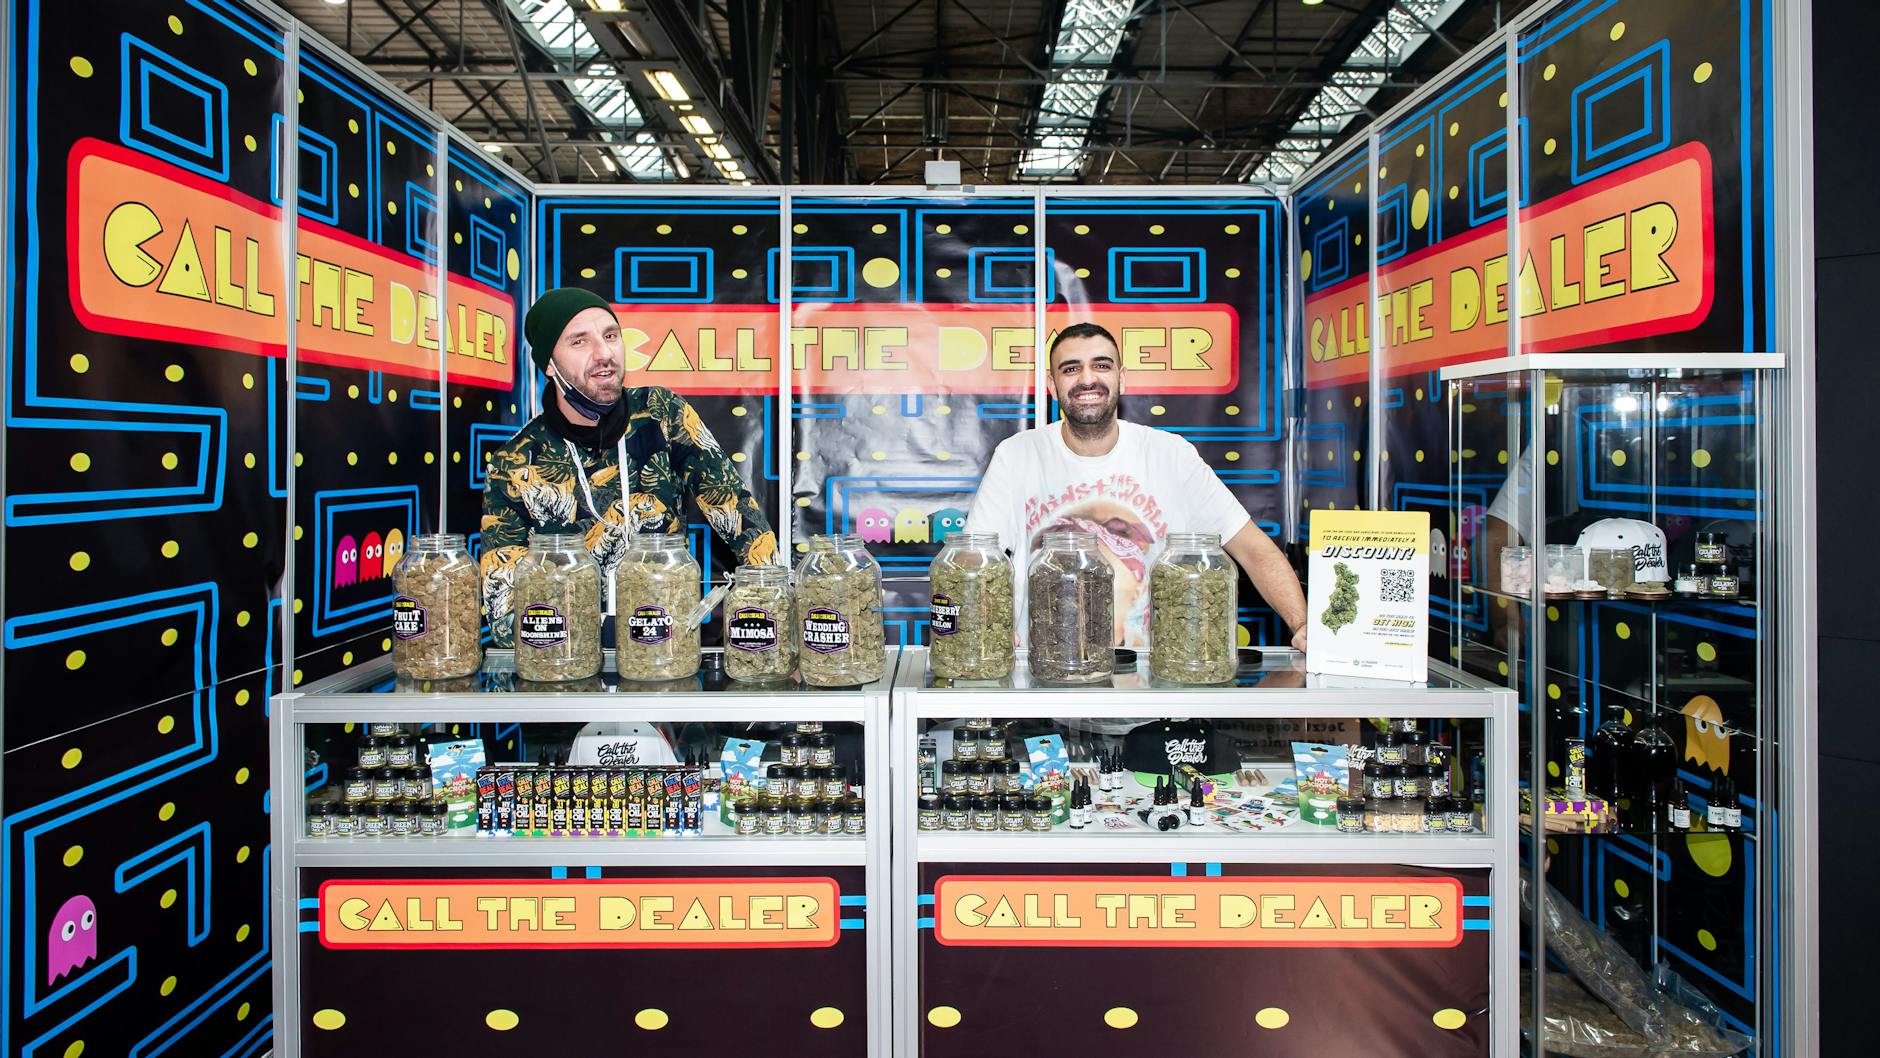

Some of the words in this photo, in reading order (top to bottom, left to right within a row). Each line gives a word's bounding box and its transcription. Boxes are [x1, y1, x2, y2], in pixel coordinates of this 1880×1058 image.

[103, 201, 275, 316] CALL
[296, 252, 374, 336] THE
[1310, 304, 1370, 363] CALL
[1377, 278, 1434, 348] THE
[1449, 201, 1680, 333] DEALER
[621, 327, 772, 372] CALL
[791, 327, 909, 371] THE
[937, 327, 1214, 371] DEER
[1322, 544, 1416, 560] DISCOUNT!
[394, 610, 420, 621] FRUIT
[523, 616, 563, 624] ALIENS
[629, 615, 674, 626] GELATO
[395, 621, 418, 631] CAKE
[642, 626, 657, 636] 24
[805, 620, 846, 632] WEDDING
[520, 630, 567, 638] MOONSHINE
[730, 627, 776, 639] MIMOSA
[803, 630, 849, 643] CRASHER
[598, 742, 620, 757] Call
[1165, 738, 1189, 753] Call
[600, 755, 640, 768] Dealer
[1167, 751, 1207, 765] Dealer
[338, 897, 463, 931] CALL
[477, 897, 576, 931] THE
[599, 895, 820, 930] DEALER
[954, 893, 1081, 928] CALL
[1095, 893, 1196, 928] THE
[1219, 893, 1442, 929] DEALER
